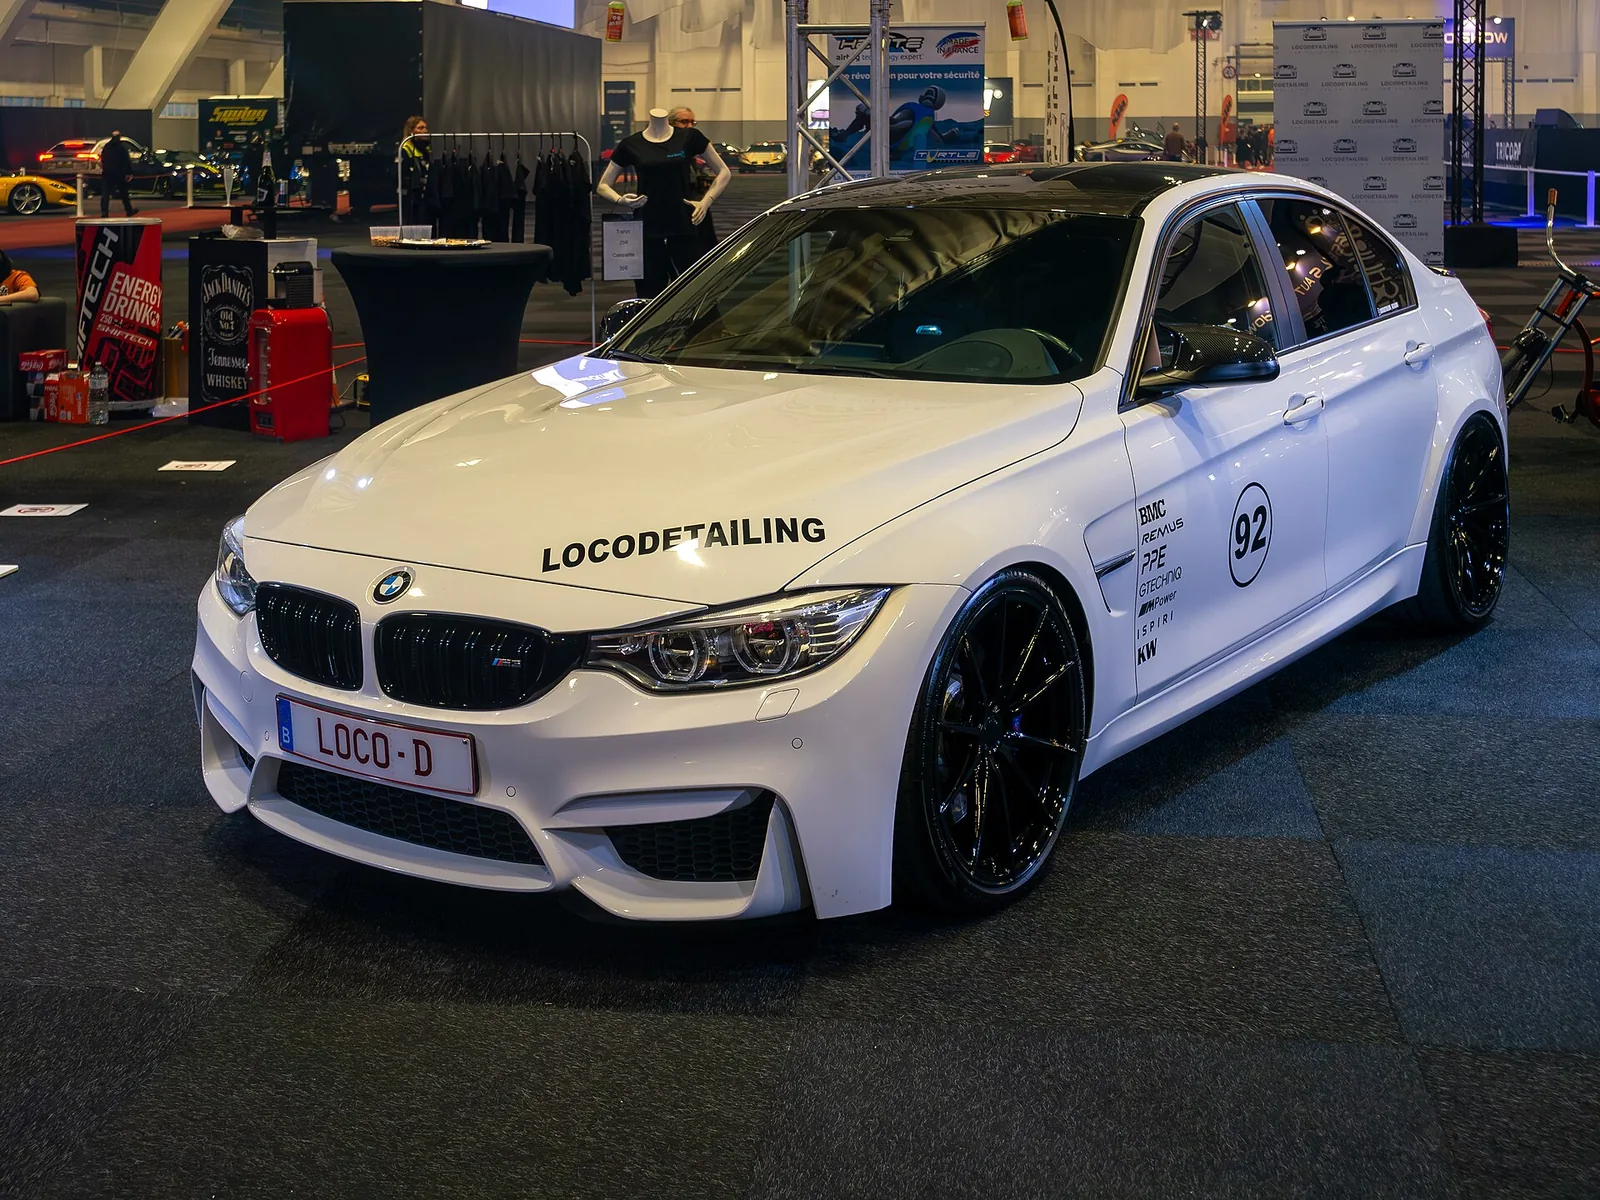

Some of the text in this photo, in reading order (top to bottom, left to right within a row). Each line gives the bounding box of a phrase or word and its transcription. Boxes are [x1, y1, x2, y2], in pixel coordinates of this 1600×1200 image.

[946, 46, 979, 54] FRANCE
[898, 73, 919, 81] pour
[943, 70, 980, 79] sécurité
[110, 271, 162, 308] ENERGY
[203, 272, 251, 307] JACK DANIEL'S
[220, 311, 233, 321] Old
[97, 323, 153, 347] SHIFTECH
[208, 347, 248, 369] Tennessee
[206, 373, 248, 390] WHISKEY
[1138, 498, 1167, 526] BMC
[541, 517, 827, 573] LOCODETAILING
[1141, 517, 1184, 546] REMUS
[1234, 504, 1268, 560] 92
[1140, 544, 1168, 576] PPE
[1138, 566, 1183, 598] GTECHNIQ
[1137, 637, 1158, 666] KW
[282, 726, 291, 744] B
